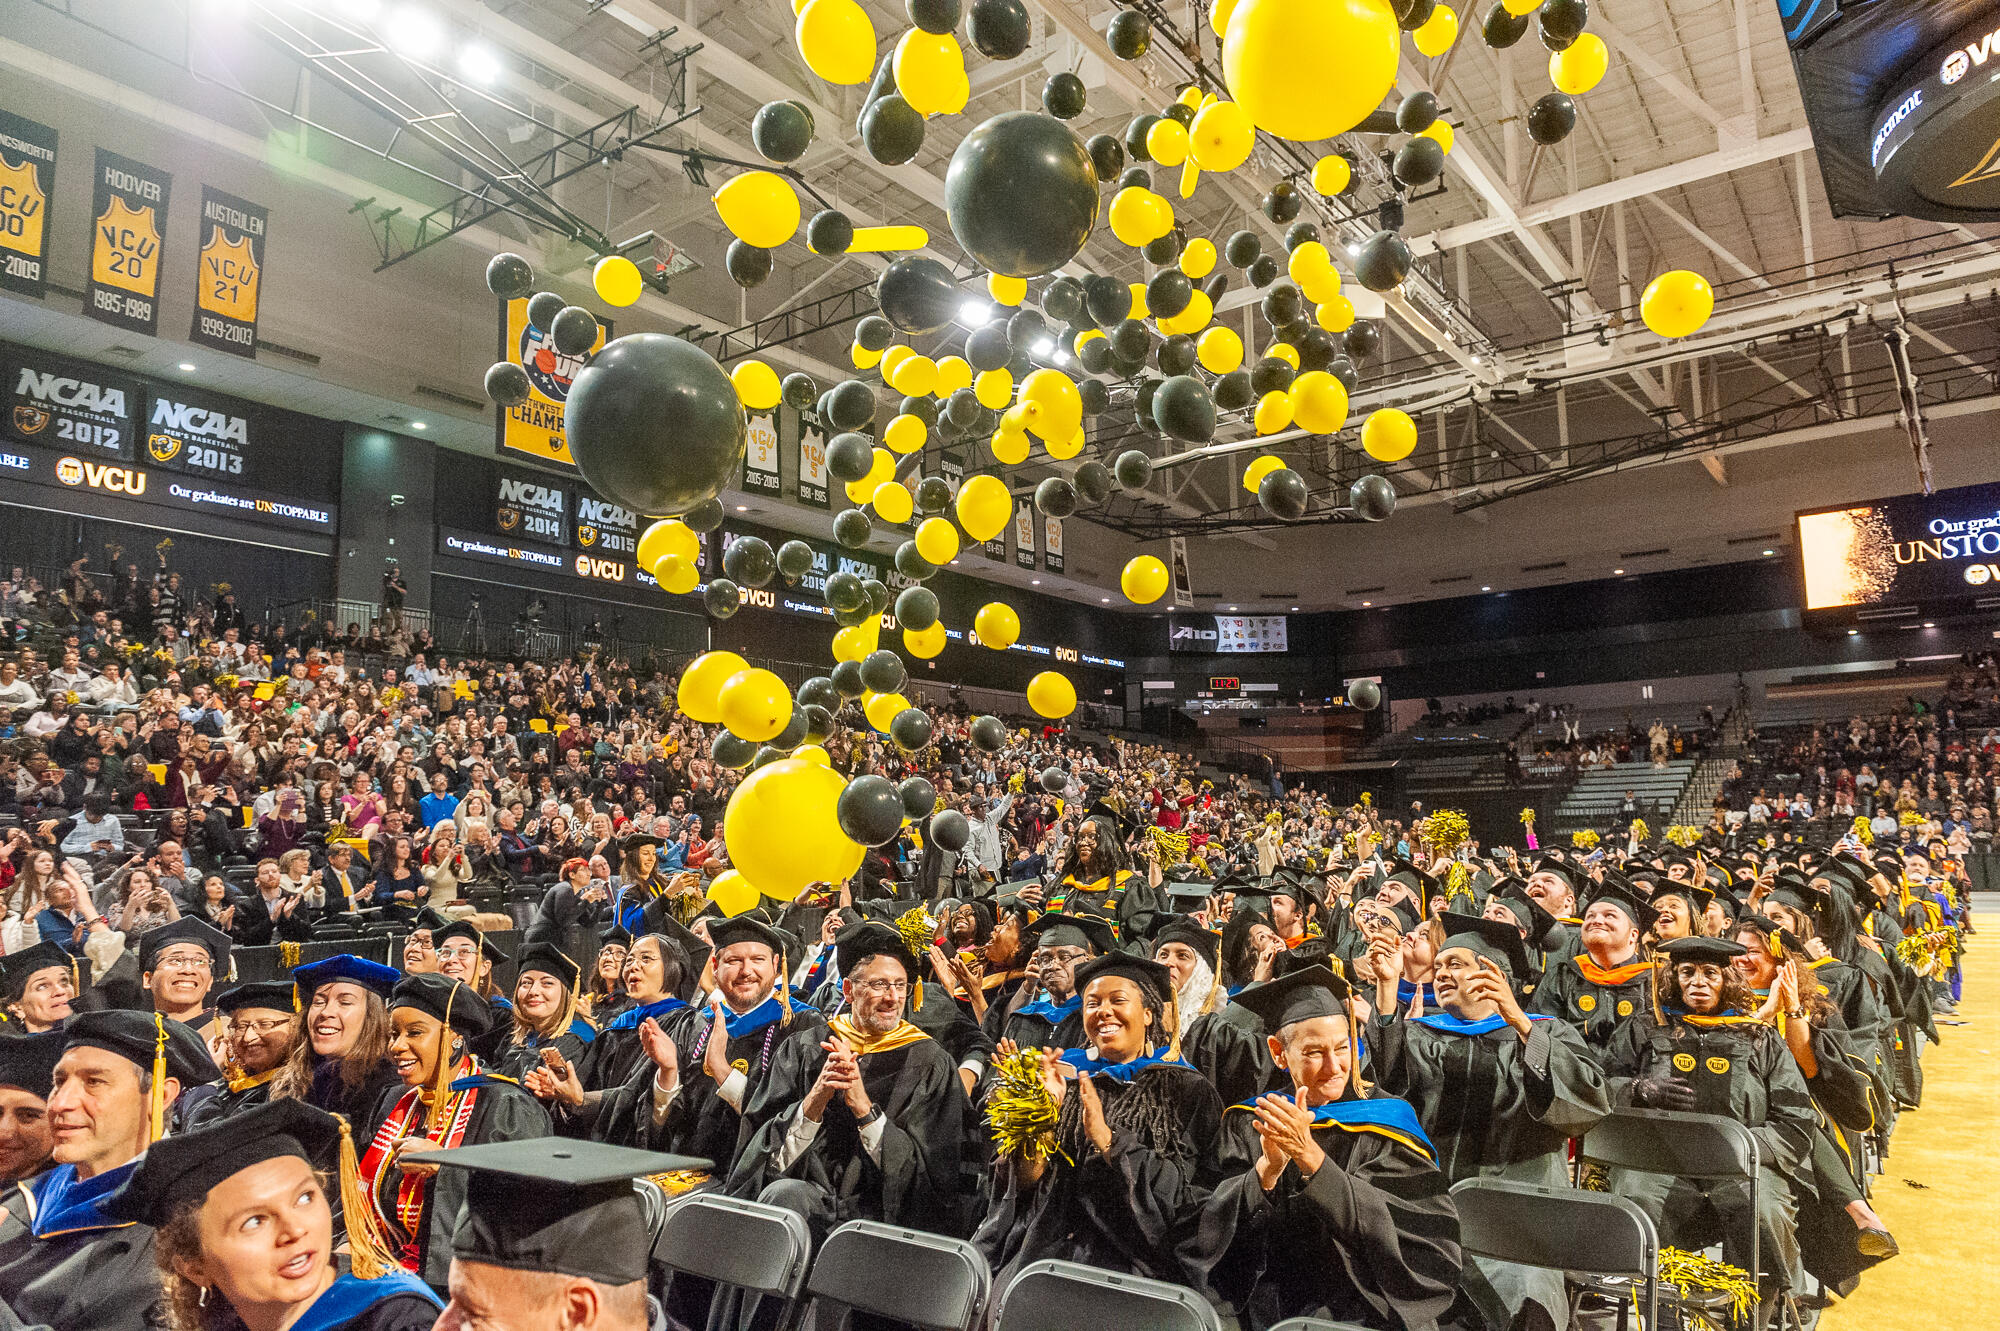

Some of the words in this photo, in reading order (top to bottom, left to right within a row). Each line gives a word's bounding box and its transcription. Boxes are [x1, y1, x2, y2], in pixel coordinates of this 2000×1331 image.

[105, 166, 161, 202] HOOVER
[205, 200, 264, 235] AUSTGULEN
[102, 225, 155, 260] VCU
[109, 251, 142, 279] 20
[207, 256, 253, 286] VCU
[94, 287, 152, 322] 1985-1989
[214, 280, 239, 304] 21
[15, 367, 128, 419] NCAA
[60, 407, 117, 425] BASKETBALL
[151, 398, 249, 445] NCAA
[57, 417, 120, 450] 2012
[163, 428, 190, 440] MEN'S
[191, 434, 240, 451] BASKETBALL
[749, 429, 776, 450] VCU
[187, 445, 243, 474] 2013
[758, 446, 767, 462] 3
[803, 444, 825, 466] VCU
[84, 462, 146, 495] VCU
[746, 470, 780, 489] 2005-2009
[941, 460, 964, 477] GRAHAM
[169, 483, 192, 499] Our
[192, 490, 238, 508] graduates
[238, 499, 255, 510] are
[255, 499, 328, 524] UNSTOPPABLE
[499, 478, 564, 513] NCAA
[578, 497, 638, 529] NCAA
[524, 515, 560, 538] 2014
[1929, 518, 1967, 535] Our
[446, 536, 463, 549] Our
[463, 541, 497, 556] graduates
[508, 547, 562, 567] UNSTOPPABLE
[601, 532, 636, 553] 2015
[589, 558, 625, 582] VCU
[748, 589, 775, 608] VCU
[1062, 648, 1078, 663] VCU
[1215, 679, 1238, 688] 11:27
